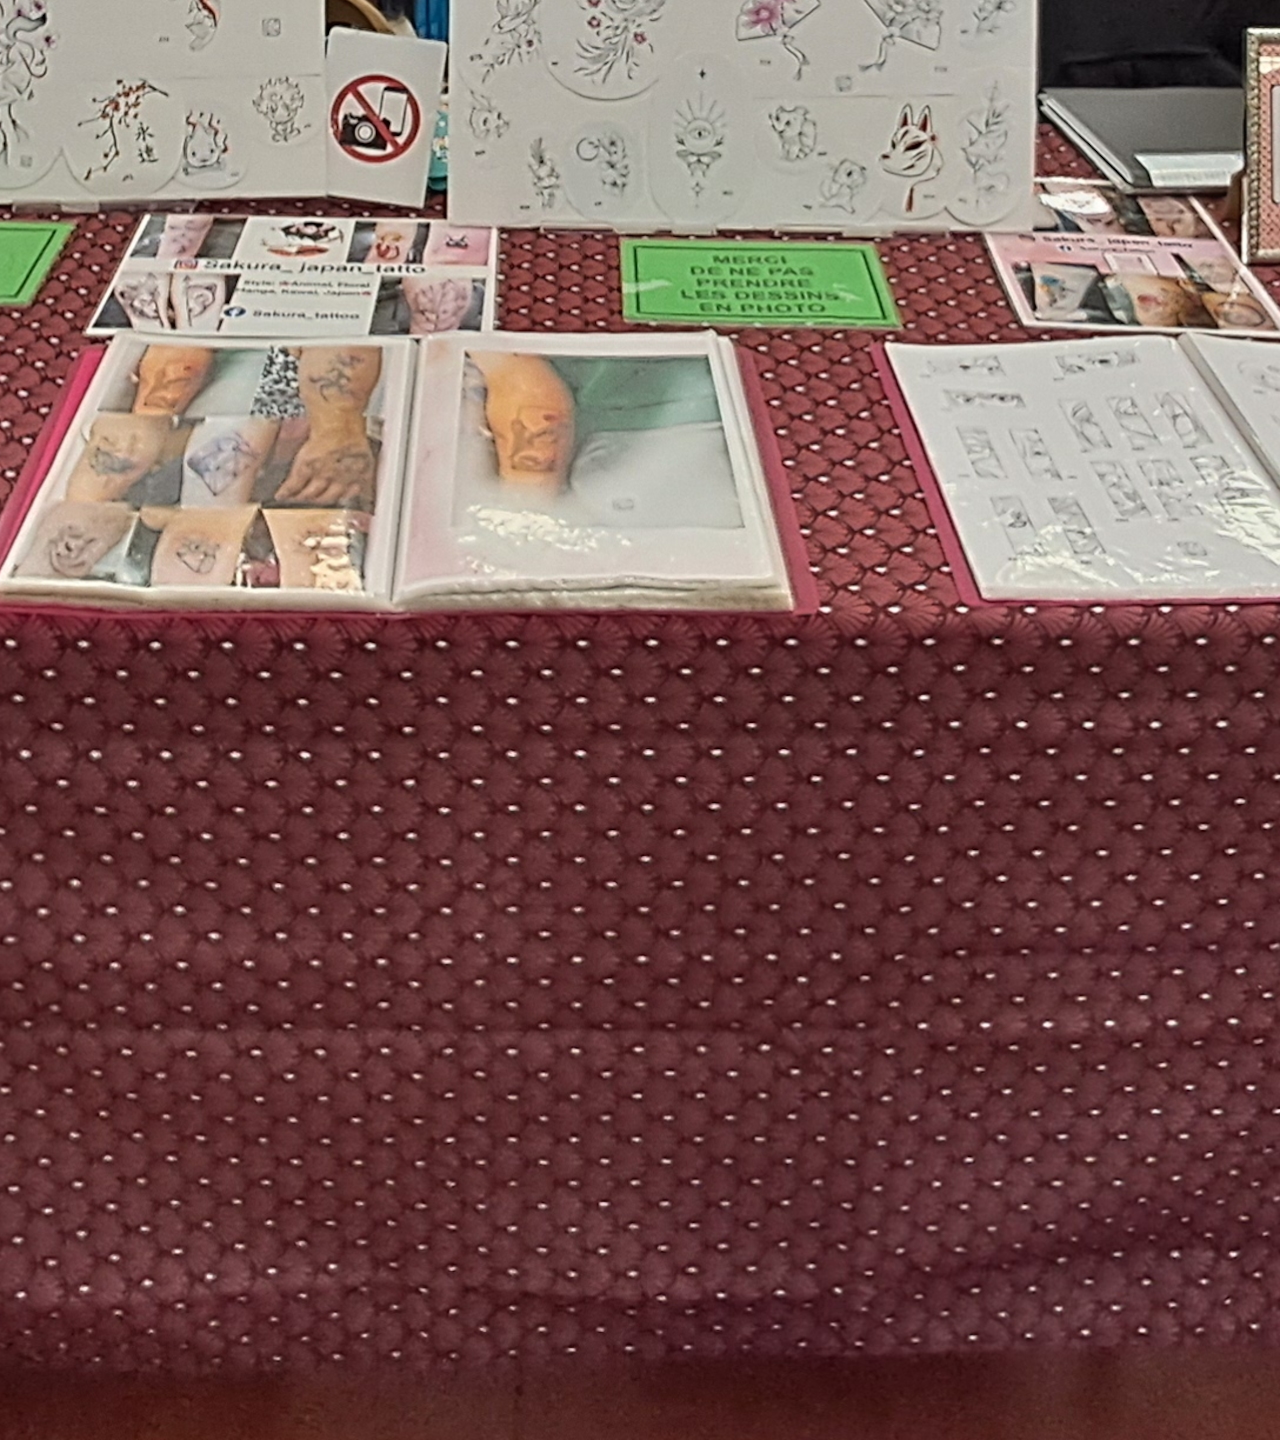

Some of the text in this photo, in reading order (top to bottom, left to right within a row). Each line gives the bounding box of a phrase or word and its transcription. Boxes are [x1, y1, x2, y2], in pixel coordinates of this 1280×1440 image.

[713, 254, 787, 265] MERCI
[690, 265, 814, 277] DE NE PAS
[696, 277, 811, 289] PRENDRE
[681, 289, 840, 302] LES DESSINS
[700, 302, 826, 314] EN PHOTO
